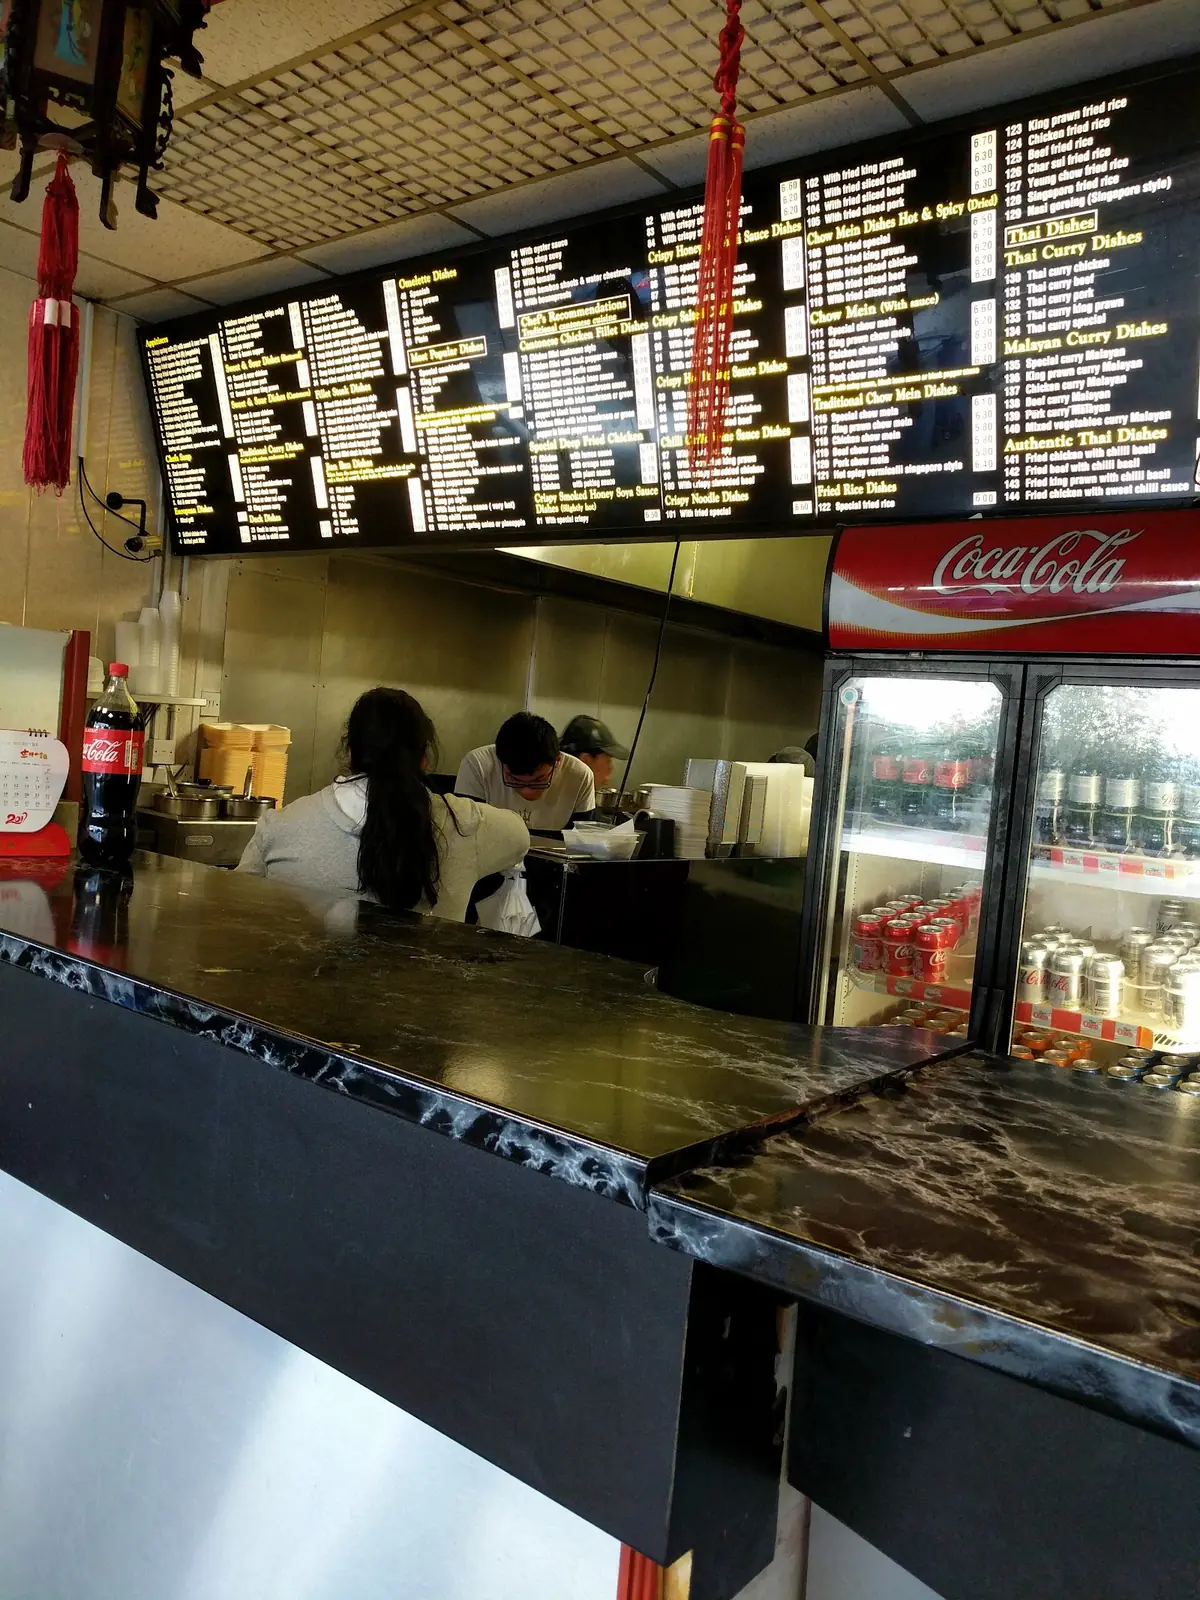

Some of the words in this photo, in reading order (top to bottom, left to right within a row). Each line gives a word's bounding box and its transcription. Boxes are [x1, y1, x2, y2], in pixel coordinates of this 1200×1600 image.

[1005, 123, 1022, 137] 123
[1029, 118, 1049, 131] King
[1051, 110, 1080, 128] prawn
[1083, 101, 1105, 118] fried
[1108, 98, 1127, 111] rice
[974, 134, 993, 148] 6.70
[1005, 138, 1022, 151] 124
[1028, 129, 1065, 146] Chicken
[1067, 121, 1089, 136] fried
[1091, 118, 1110, 130] rice
[975, 149, 993, 162] 6.30
[1005, 152, 1022, 165] 125
[1028, 145, 1049, 160] Beef
[1051, 140, 1073, 155] fried
[1075, 137, 1094, 149] rice
[823, 172, 841, 185] With
[842, 167, 860, 180] fried
[861, 164, 878, 175] king
[879, 158, 903, 173] prawn
[974, 163, 993, 177] 6.30
[1005, 166, 1022, 179] 126
[1028, 161, 1049, 174] Char
[1067, 150, 1090, 165] fried
[1092, 147, 1111, 160] rice
[975, 178, 993, 190] 6.30
[1005, 180, 1022, 193] 127
[1058, 168, 1083, 182] chow
[1085, 161, 1108, 176] fried
[1109, 158, 1129, 170] rice
[781, 181, 798, 193] 6.60
[806, 191, 820, 203] 103
[824, 186, 841, 198] With
[842, 181, 860, 194] fried
[862, 175, 885, 190] sliced
[886, 169, 916, 183] chicken
[1028, 185, 1074, 202] Singapore
[1076, 177, 1098, 192] fried
[1100, 175, 1119, 187] rice
[783, 192, 798, 204] 6.20
[1027, 202, 1048, 216] Nasi
[1142, 176, 1172, 193] style)
[784, 205, 798, 216] 6.20
[807, 231, 833, 246] Chow
[836, 224, 861, 240] Mein
[863, 216, 896, 234] Dishes
[898, 211, 918, 226] Hot
[922, 207, 933, 221] &
[936, 202, 964, 219] Spicy
[967, 194, 998, 212] (Dried)
[744, 230, 769, 243] Sauce
[771, 221, 802, 237] Dishes
[1008, 225, 1041, 244] Thai
[1046, 218, 1095, 236] Dishes
[648, 250, 674, 263] Crispy
[676, 244, 702, 258] Honey
[975, 240, 992, 252] 6.20
[1004, 248, 1037, 266] Thai
[1042, 243, 1086, 259] Curry
[1092, 231, 1142, 251] Dishes
[432, 268, 457, 281] Dishes
[1027, 268, 1047, 280] Thai
[1048, 265, 1072, 277] curry
[1005, 299, 1021, 311] 132
[1027, 295, 1046, 307] Thai
[1048, 293, 1072, 304] curry
[1073, 287, 1094, 302] pork
[521, 315, 547, 328] Chef's
[548, 301, 627, 323] Recommendations
[809, 310, 842, 325] Chow
[845, 303, 877, 319] Mein
[880, 299, 908, 314] (With
[560, 330, 594, 344] Chicken
[595, 325, 618, 338] Fillet
[620, 320, 649, 334] Dishes
[1004, 338, 1062, 355] Malayan
[1066, 331, 1111, 346] Curry
[1116, 321, 1167, 339] Dishes
[459, 342, 484, 354] Dishes
[1004, 360, 1020, 371] 135
[1026, 355, 1059, 370] Special
[1060, 353, 1084, 364] curry
[349, 382, 371, 394] Dishes
[865, 391, 893, 405] Chow
[895, 387, 921, 401] Mein
[924, 383, 958, 398] Dishes
[607, 431, 644, 444] Chicken
[1004, 434, 1074, 452] Authentic
[1077, 430, 1112, 446] Thai
[1117, 426, 1167, 442] Dishes
[1004, 454, 1019, 464] 141
[1026, 452, 1048, 463] Fried
[1085, 447, 1105, 458] with
[534, 493, 557, 504] Crispy
[589, 489, 614, 500] Honey
[616, 487, 634, 498] Soya
[636, 486, 658, 496] Sauce
[665, 495, 689, 507] Crispy
[691, 492, 720, 504] Noodle
[722, 490, 749, 502] Dishes
[817, 484, 841, 497] Fried
[843, 483, 864, 495] Rice
[866, 481, 897, 494] Dishes
[1004, 491, 1020, 501] 144
[1025, 489, 1047, 500] Fried
[1084, 486, 1104, 496] with
[1161, 482, 1189, 492] sauce
[680, 509, 694, 518] With
[818, 502, 831, 512] 122
[835, 501, 861, 512] Special
[862, 500, 879, 509] fried
[881, 499, 895, 508] rice
[264, 513, 281, 522] Dishes
[933, 528, 1145, 596] Coca-Cola
